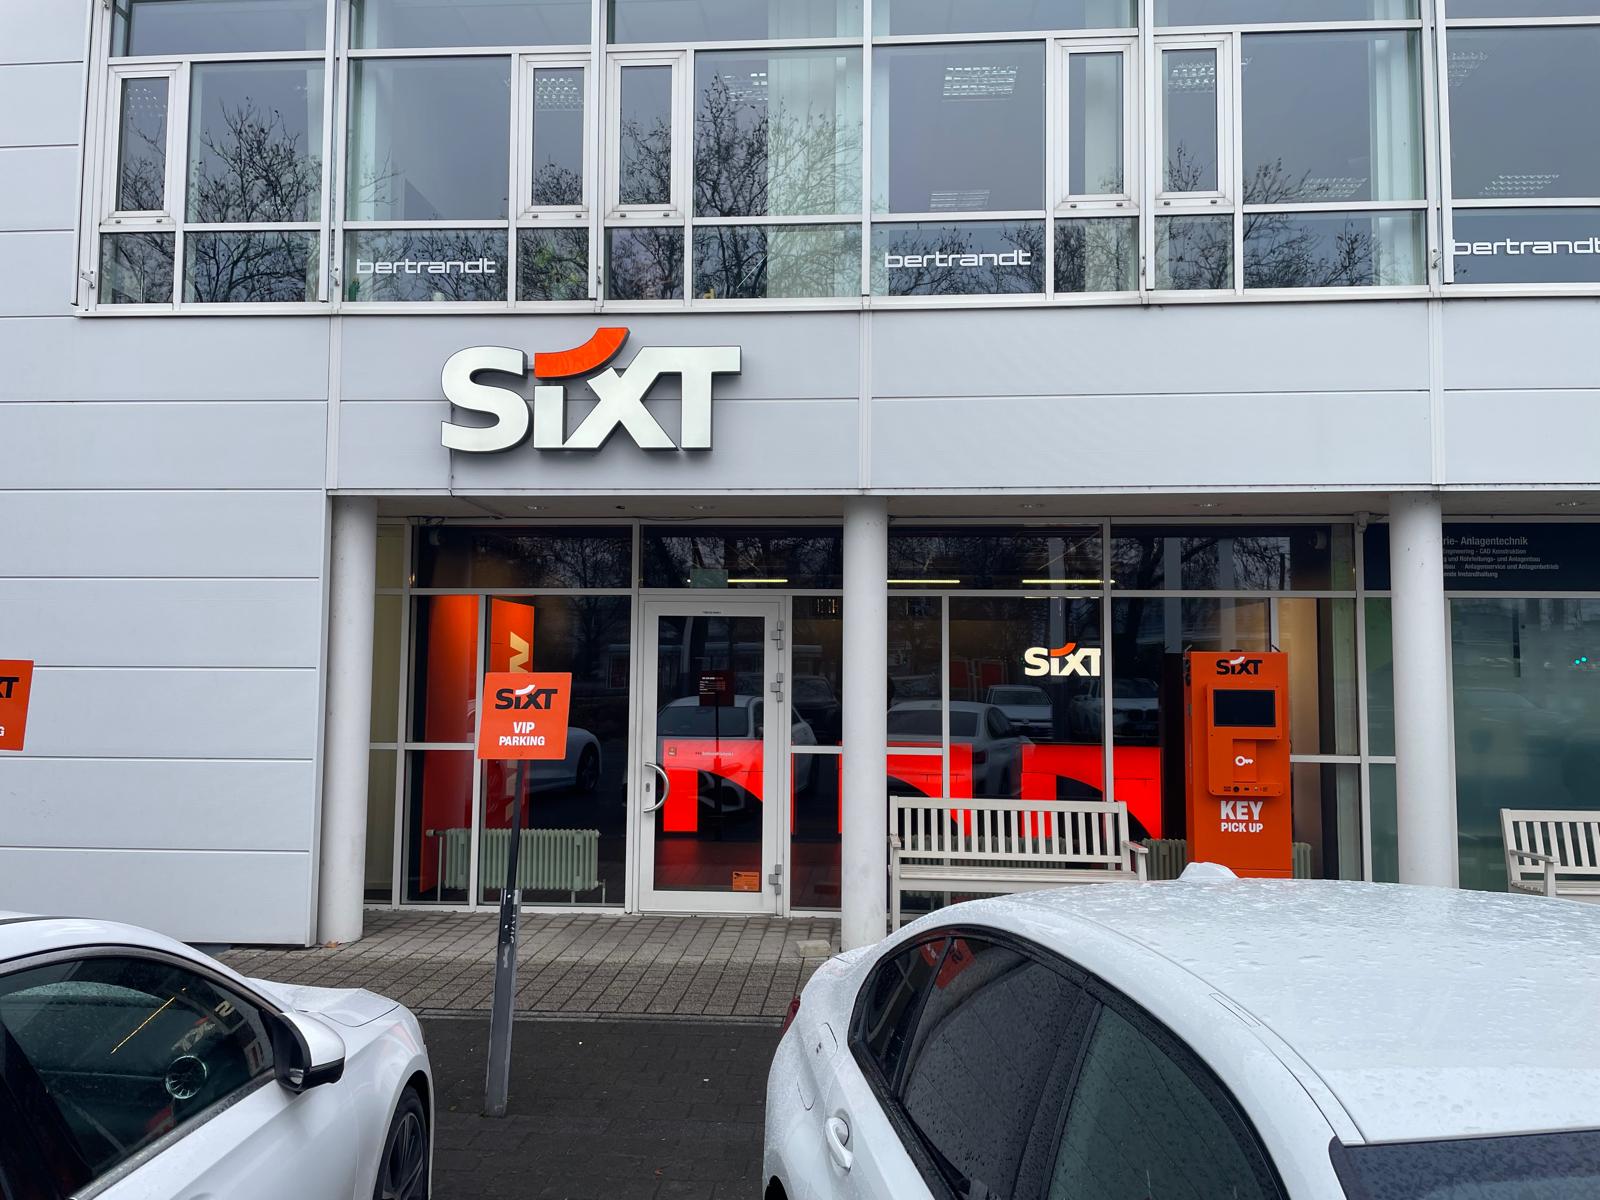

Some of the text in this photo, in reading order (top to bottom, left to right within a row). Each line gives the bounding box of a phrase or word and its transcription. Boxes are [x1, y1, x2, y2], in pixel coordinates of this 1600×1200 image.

[356, 257, 496, 274] bertrandt
[884, 249, 1031, 268] bertrandt
[441, 327, 742, 453] SIXT
[1461, 536, 1528, 547] Anlagentechnik
[1024, 642, 1101, 677] SIXT
[1216, 656, 1263, 675] SIXT
[495, 684, 558, 710] SIXT
[513, 721, 535, 734] VIP
[499, 735, 545, 746] PARKING
[1220, 800, 1263, 820] KEY
[1220, 822, 1263, 833] PICK UP
